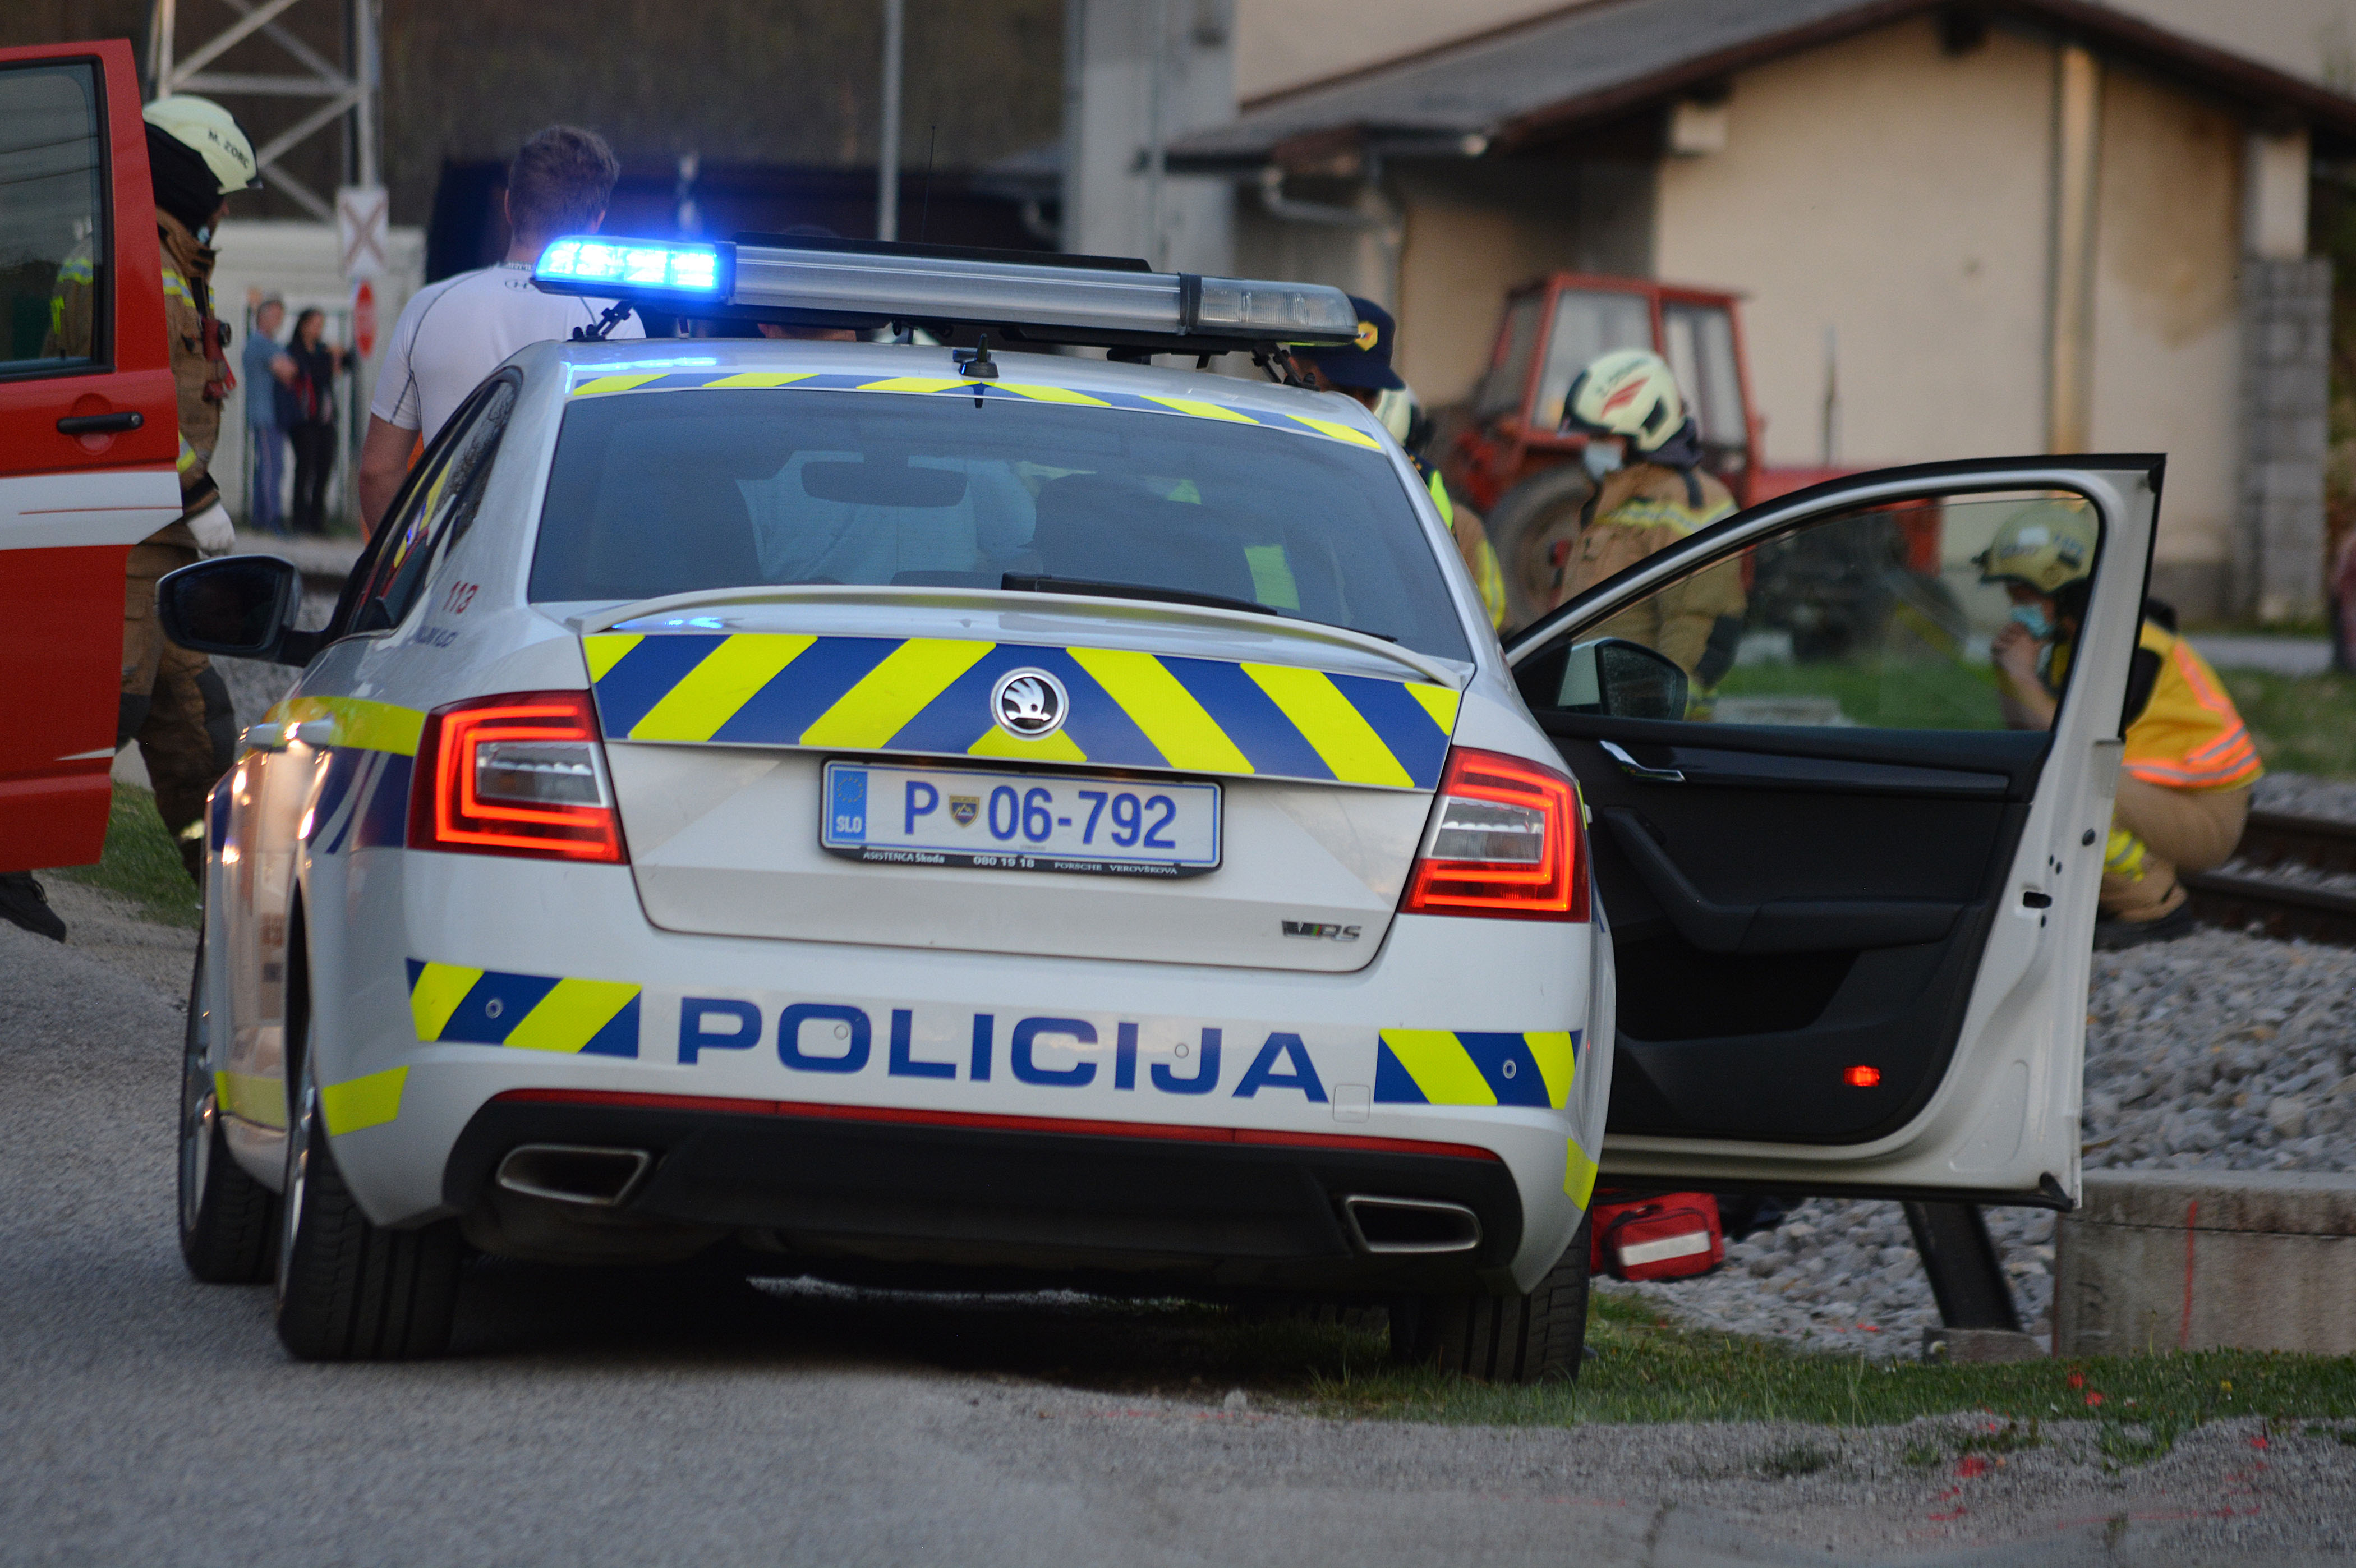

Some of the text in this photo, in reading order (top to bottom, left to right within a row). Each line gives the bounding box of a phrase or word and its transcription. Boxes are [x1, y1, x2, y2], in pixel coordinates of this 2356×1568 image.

[442, 580, 479, 614] 113
[836, 815, 862, 834] SLO
[905, 780, 1177, 849] P 06-792
[863, 851, 914, 862] ASISTENCA
[973, 856, 997, 866] 080
[1001, 858, 1016, 867] 19
[1020, 859, 1035, 868] 18
[1054, 861, 1102, 871] PORSCHE
[677, 996, 1330, 1103] POLICIJA
